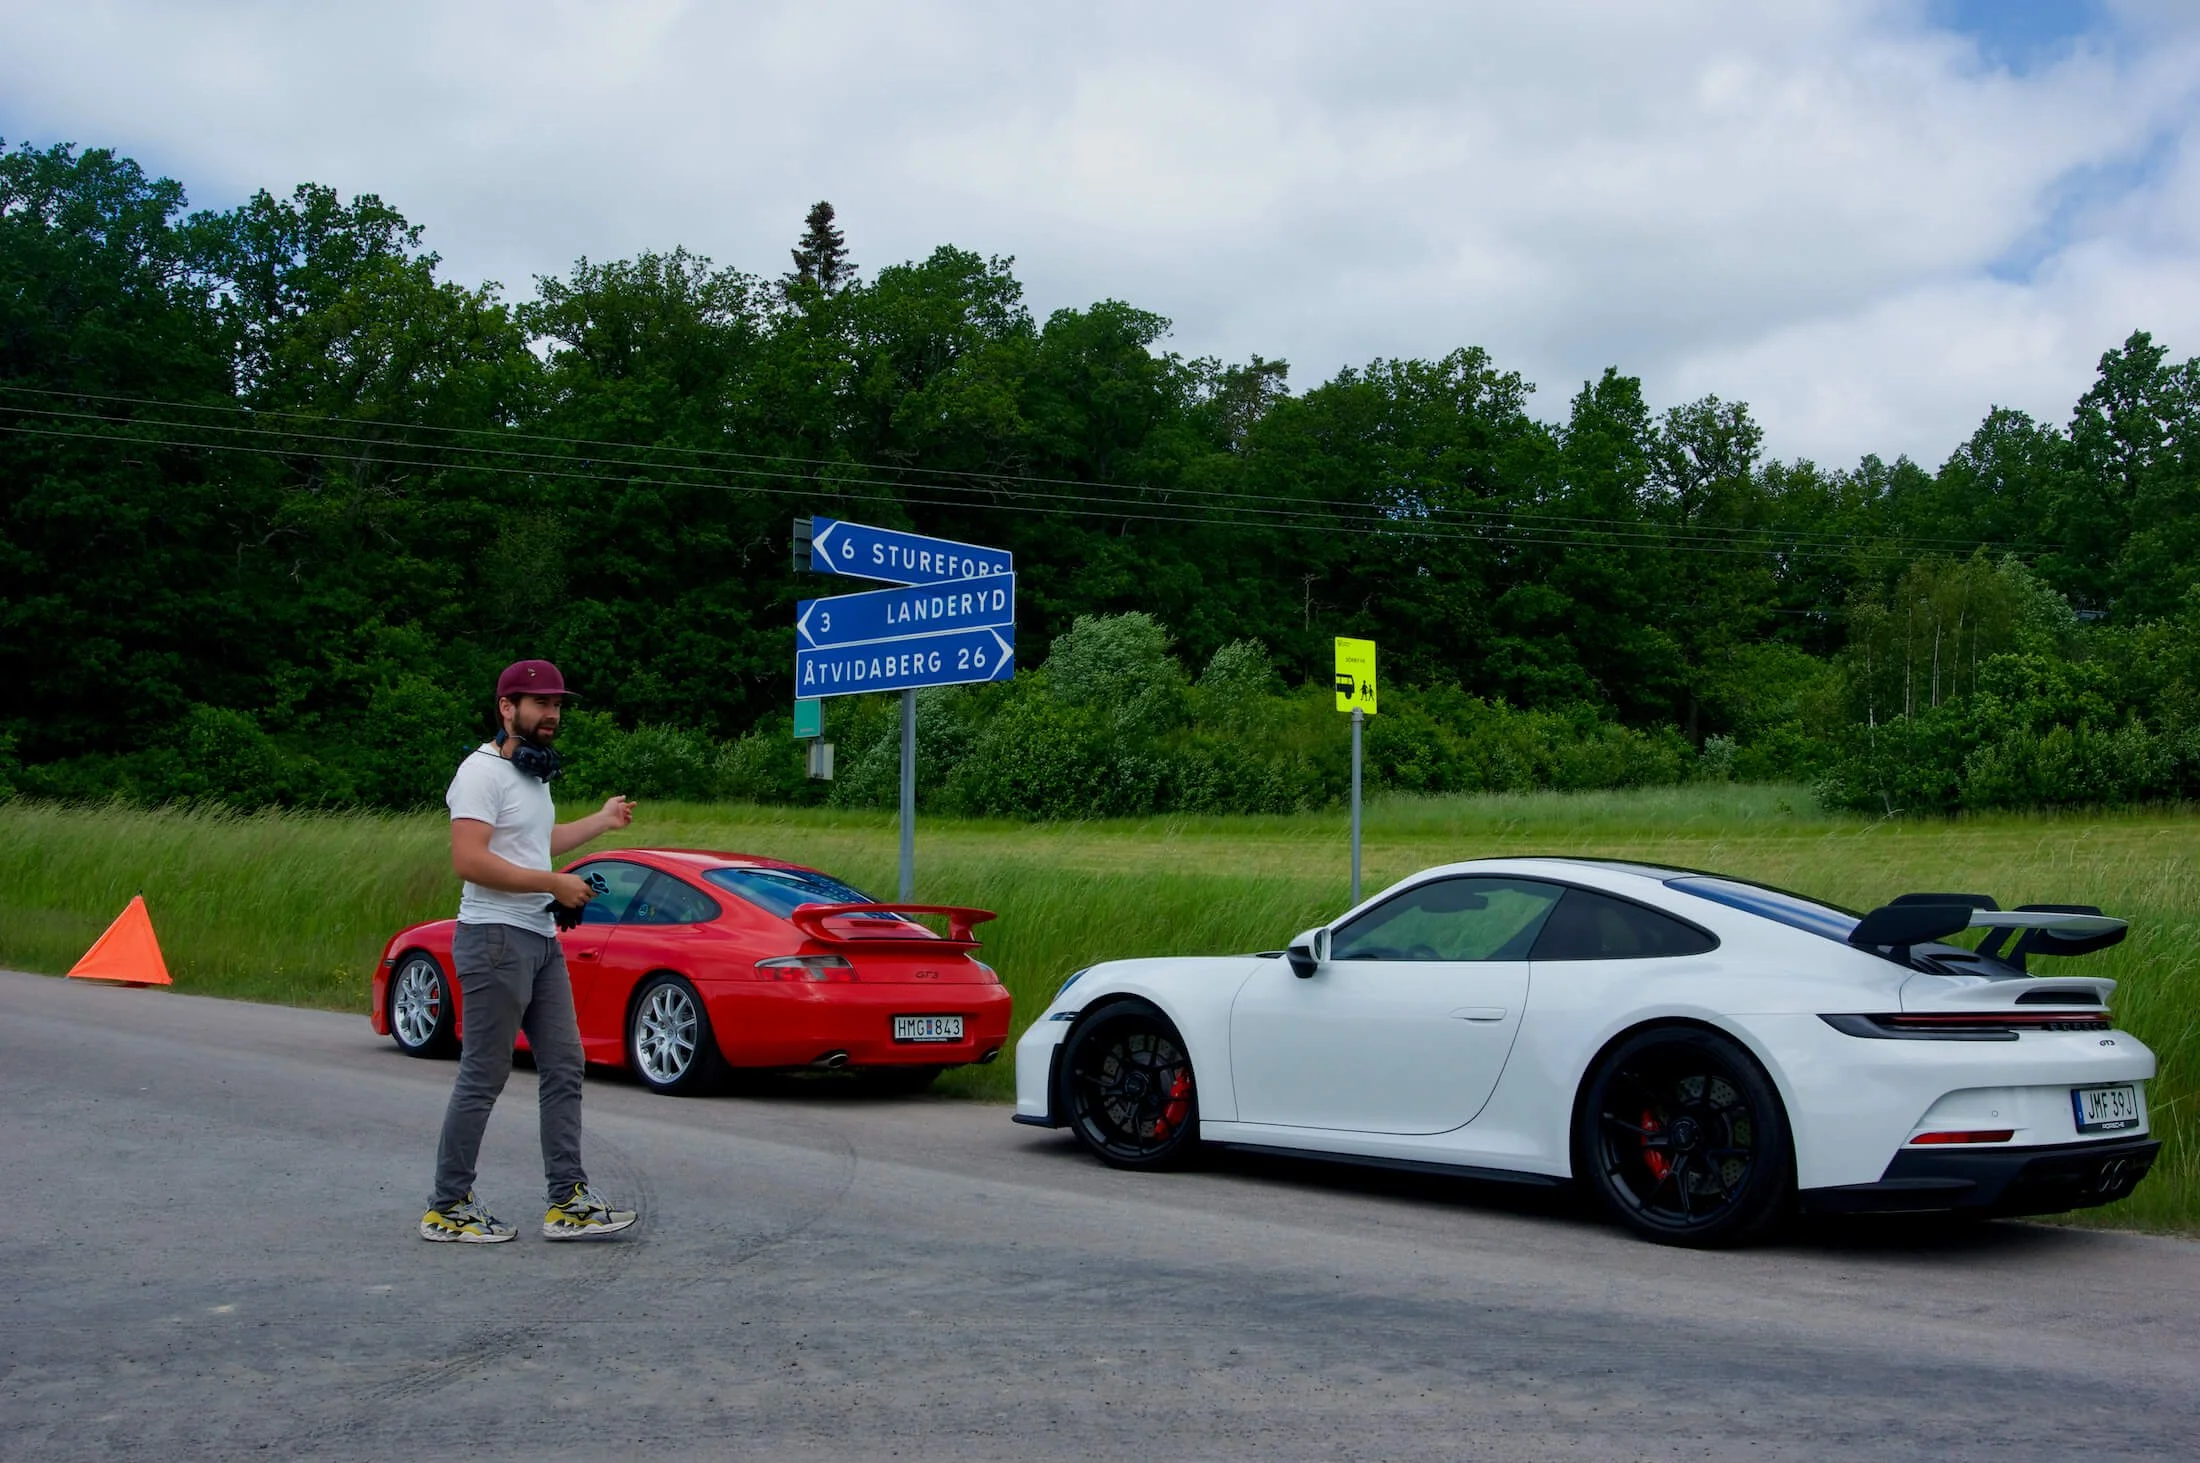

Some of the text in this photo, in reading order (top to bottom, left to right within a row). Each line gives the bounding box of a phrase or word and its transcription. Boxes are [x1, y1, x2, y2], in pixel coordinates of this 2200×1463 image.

[842, 538, 855, 560] 6
[820, 589, 1006, 632] 3 LANDERYD
[803, 646, 986, 686] ÅTVIDABERG 26
[916, 971, 938, 979] GT3
[898, 1019, 960, 1037] HMG 843
[2088, 1090, 2132, 1120] JMF 39J
